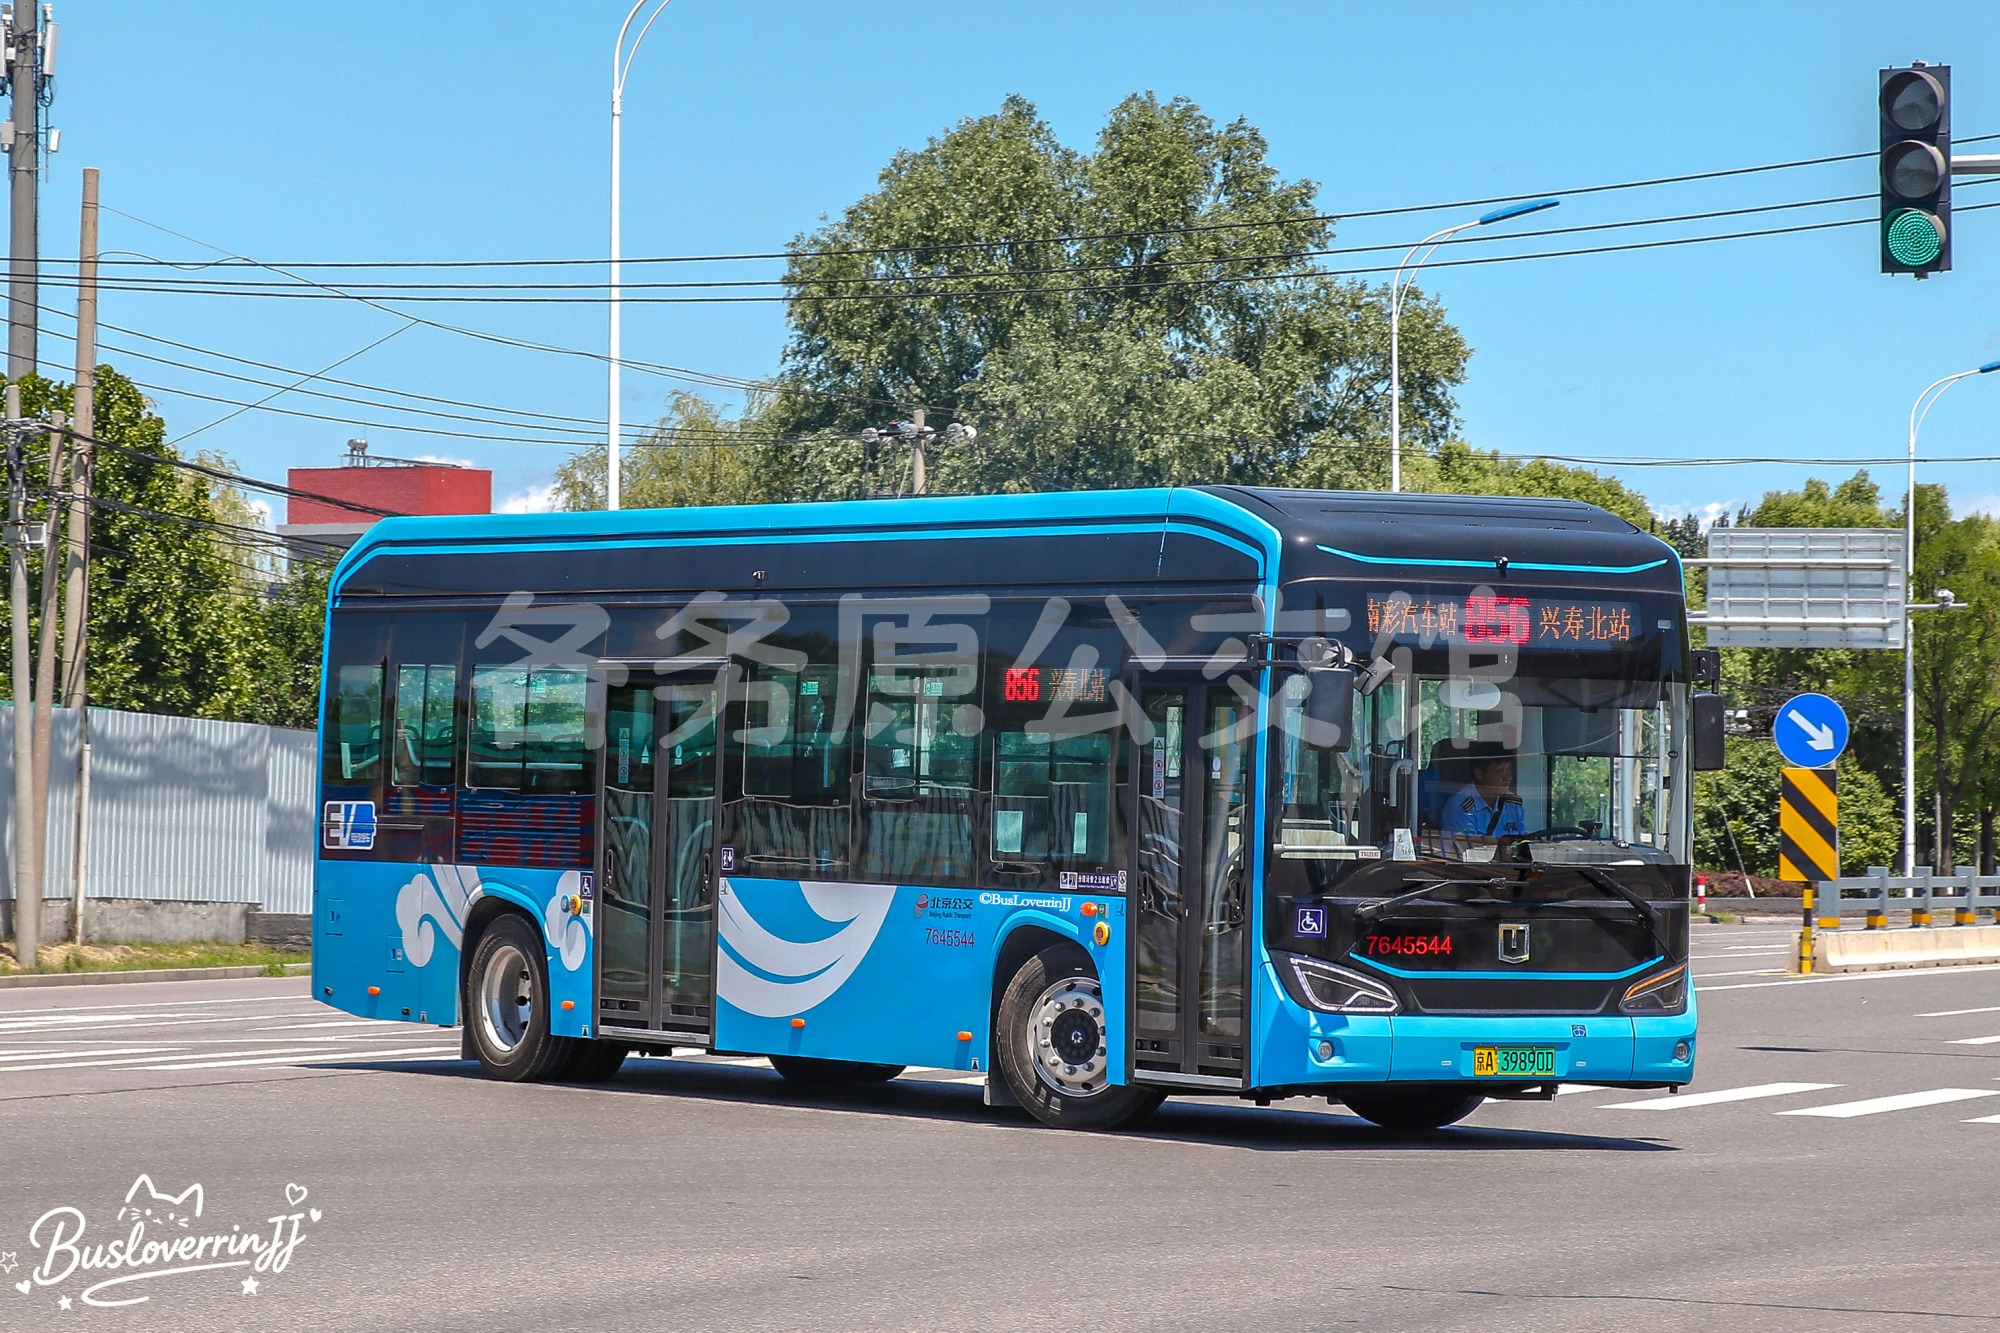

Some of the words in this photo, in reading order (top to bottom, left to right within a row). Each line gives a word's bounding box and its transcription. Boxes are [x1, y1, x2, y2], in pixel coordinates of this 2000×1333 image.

[1464, 595, 1531, 645] 856
[1539, 605, 1631, 641] 兴寿北站
[1004, 667, 1040, 701] 856
[1049, 668, 1106, 702] 兴寿北站
[930, 897, 974, 910] 北京公交
[926, 928, 975, 948] 7645544
[1366, 936, 1453, 955] 7645544
